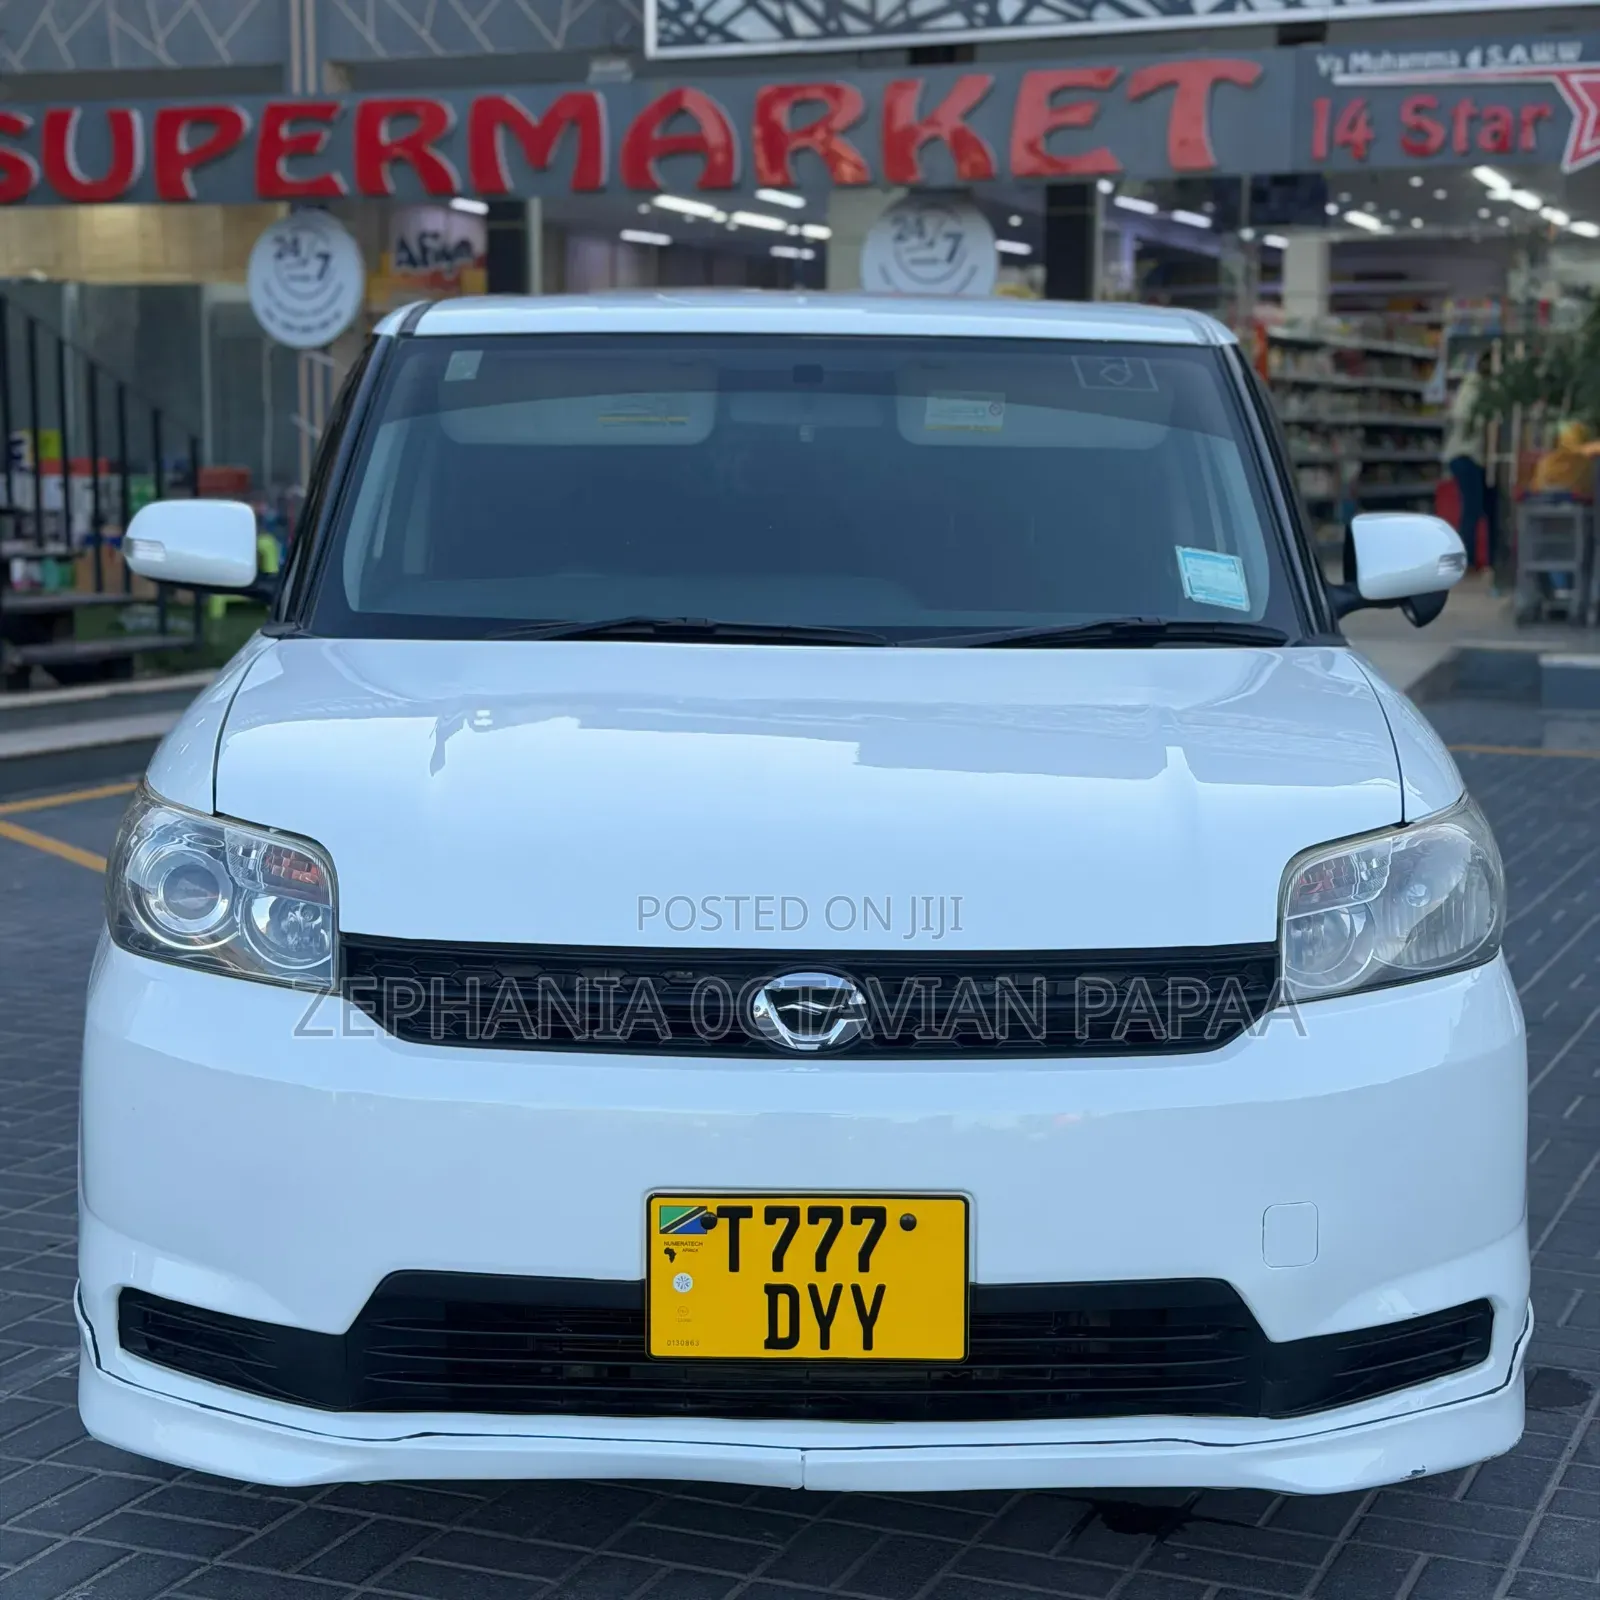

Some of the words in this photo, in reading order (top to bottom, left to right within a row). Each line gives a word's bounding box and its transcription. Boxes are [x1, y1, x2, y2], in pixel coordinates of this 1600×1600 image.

[1310, 95, 1376, 162] 14
[1398, 93, 1553, 158] Star
[663, 1240, 704, 1248] NUMERATECH
[763, 1283, 887, 1351] DYY
